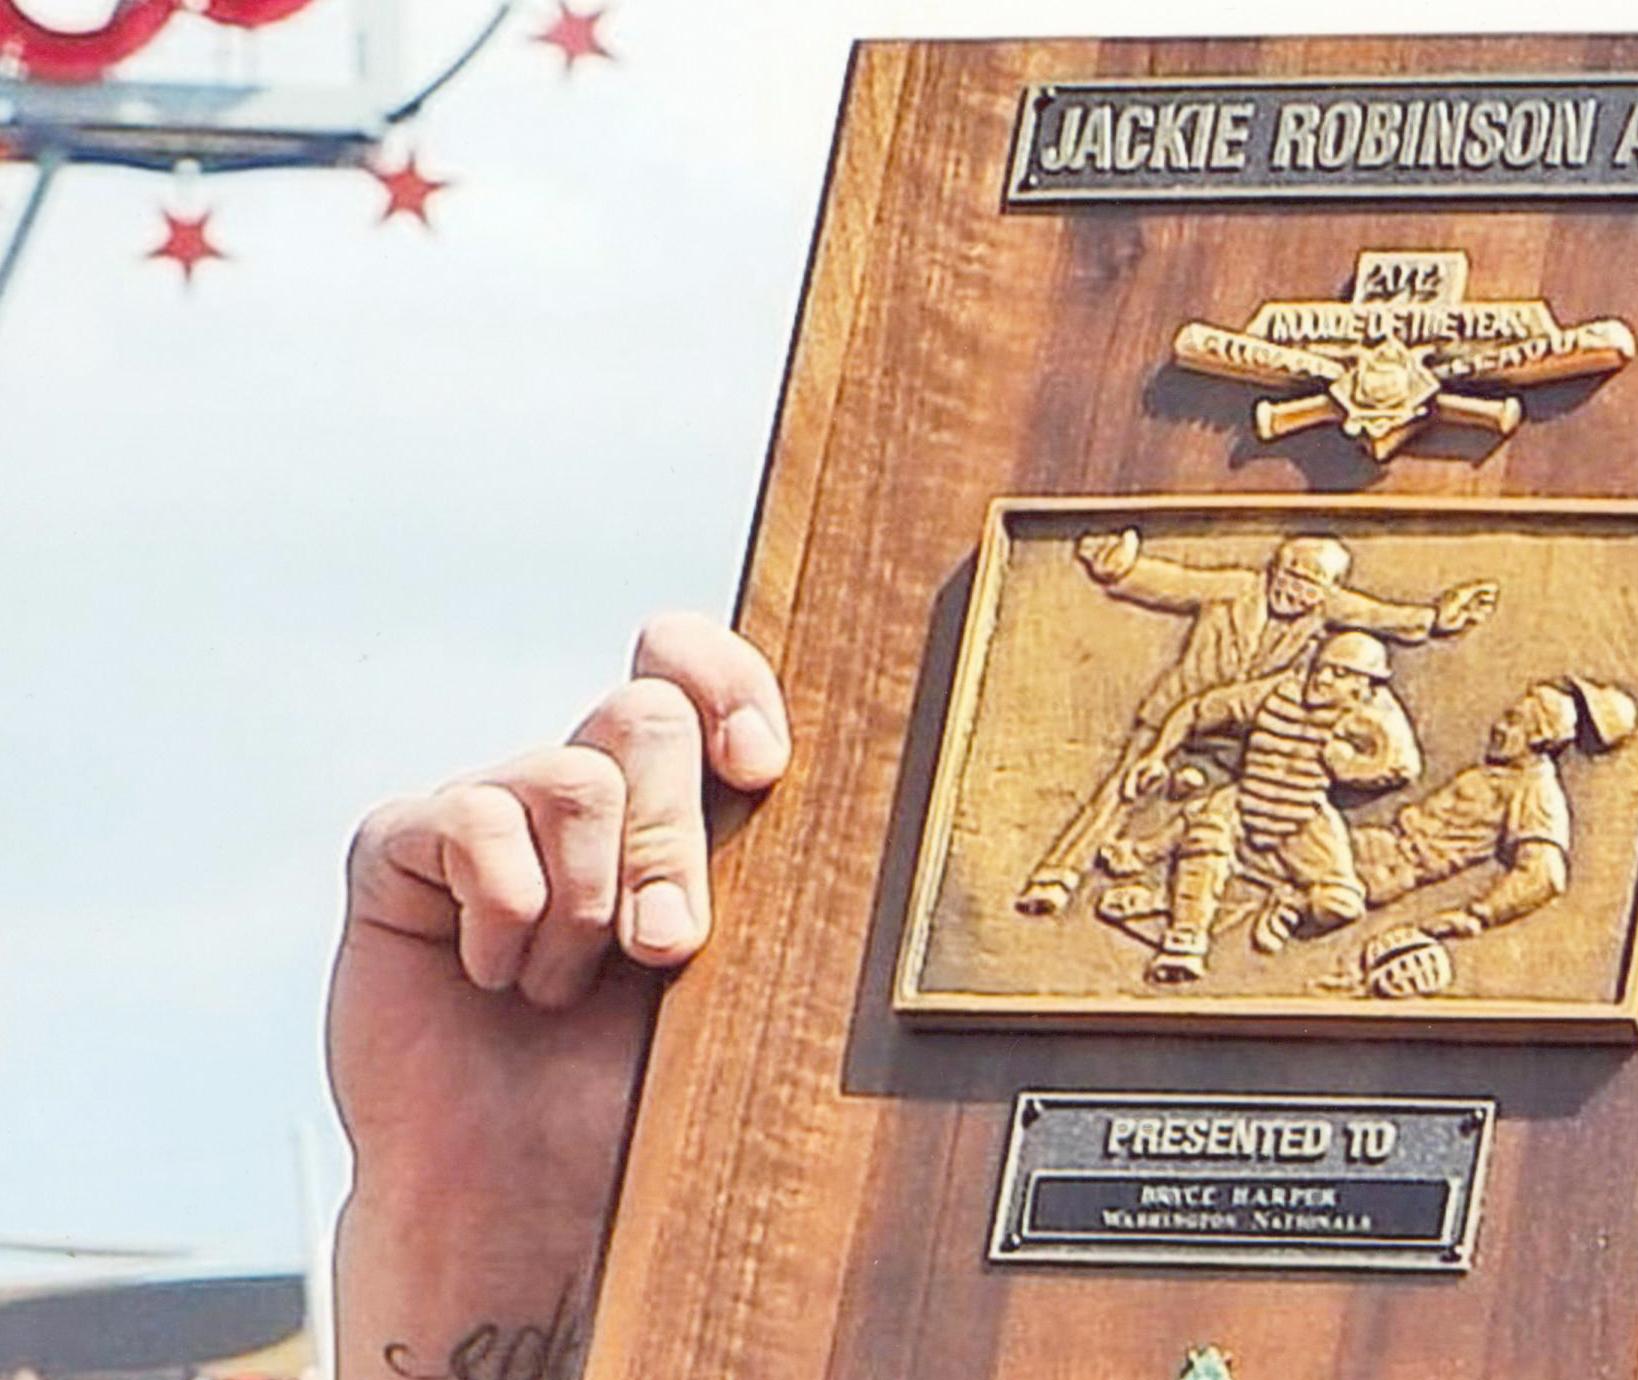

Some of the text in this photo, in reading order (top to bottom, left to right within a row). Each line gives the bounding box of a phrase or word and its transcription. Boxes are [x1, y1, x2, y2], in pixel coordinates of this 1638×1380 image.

[1042, 100, 1253, 174] JACKIE
[1270, 98, 1598, 172] ROBINSON
[1107, 1117, 1398, 1162] PRESENTED TO
[1231, 1186, 1338, 1208] HARPER
